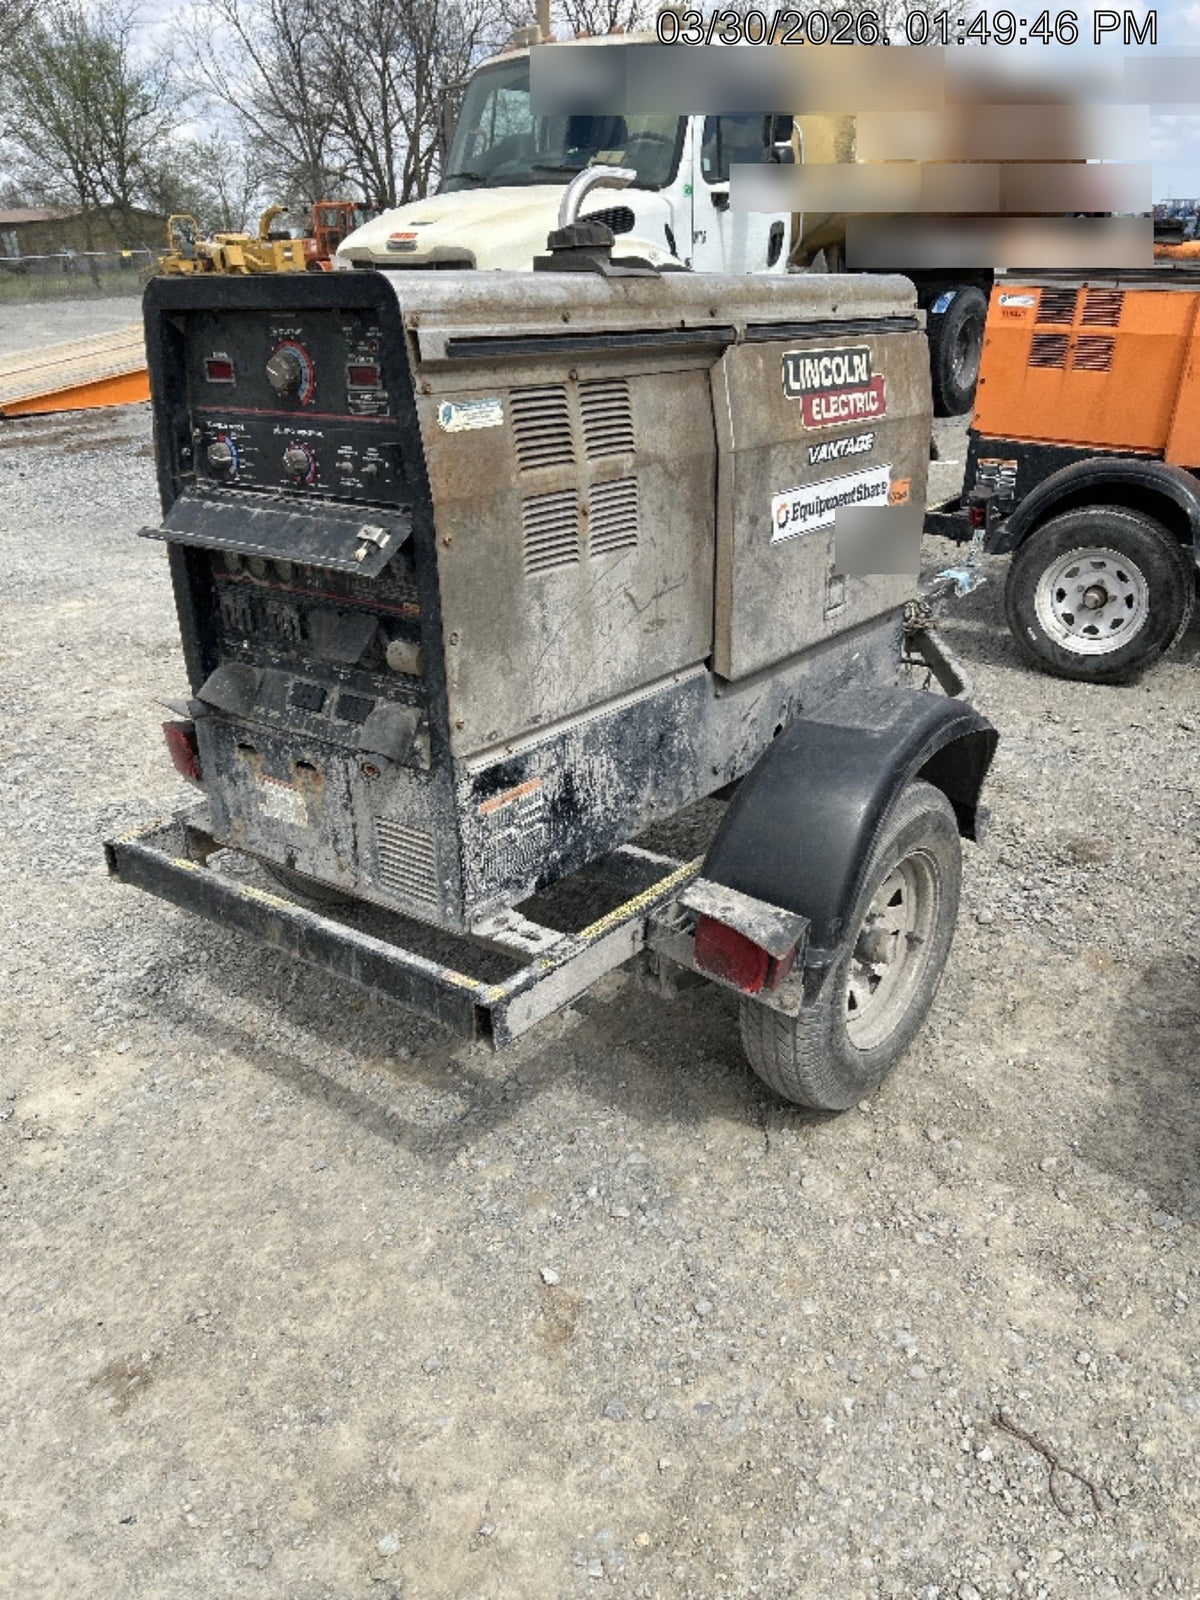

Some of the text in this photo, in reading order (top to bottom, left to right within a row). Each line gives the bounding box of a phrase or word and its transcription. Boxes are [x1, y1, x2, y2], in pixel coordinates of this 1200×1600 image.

[787, 353, 868, 390] LINCOLN
[811, 390, 879, 421] ELECTRIC
[809, 432, 875, 465] VANTAGE
[791, 480, 888, 522] EquipmentShare
